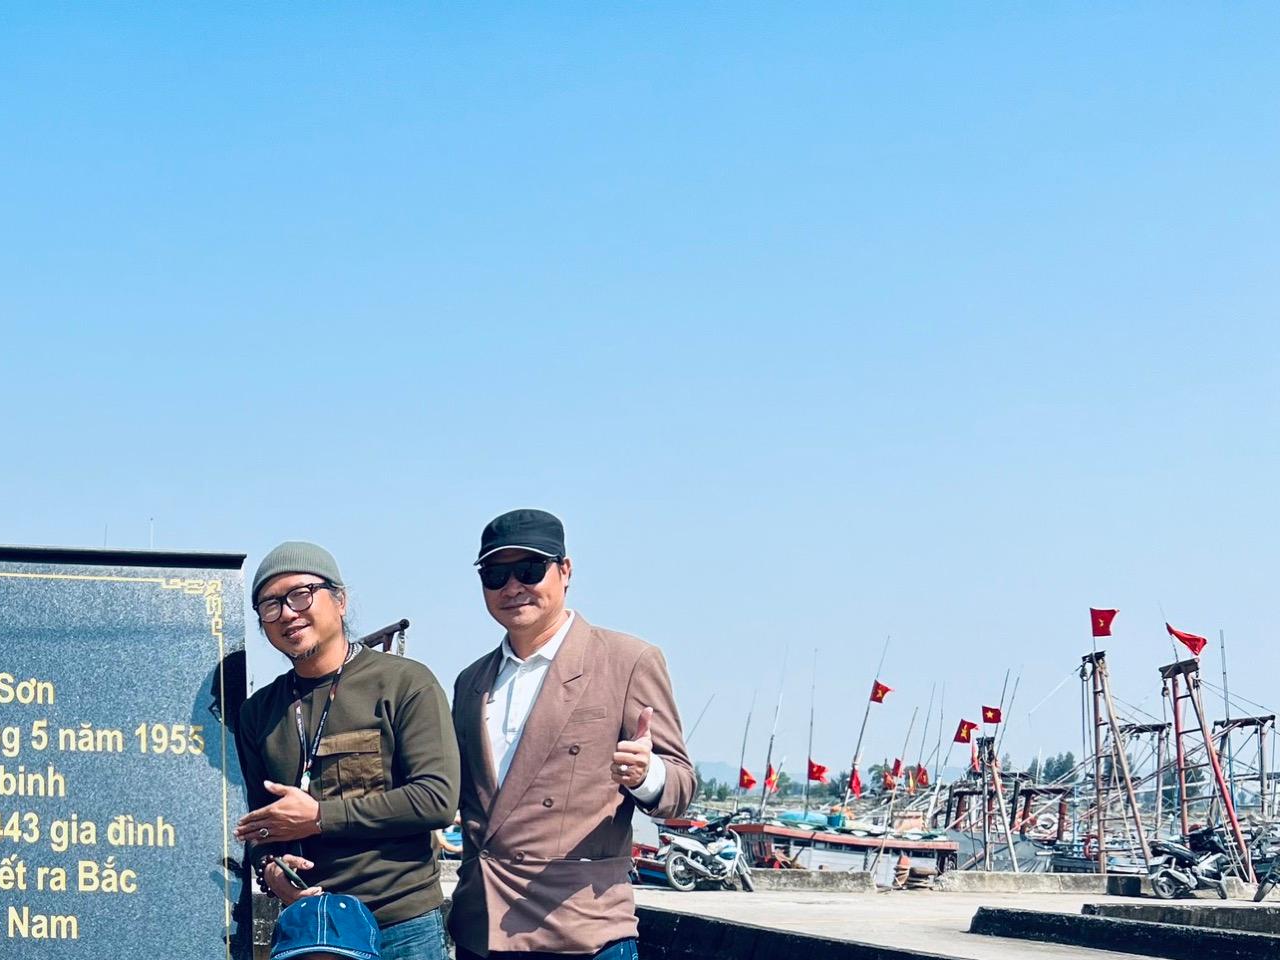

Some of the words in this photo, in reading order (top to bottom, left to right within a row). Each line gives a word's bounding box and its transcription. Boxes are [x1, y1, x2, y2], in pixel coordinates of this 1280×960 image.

[32, 719, 49, 749] 5
[60, 721, 124, 752] năm
[136, 723, 205, 754] 1955
[51, 814, 97, 852] gia
[107, 814, 175, 846] đình
[37, 866, 67, 892] ra
[78, 856, 137, 893] Bắc
[8, 906, 79, 939] Nam
